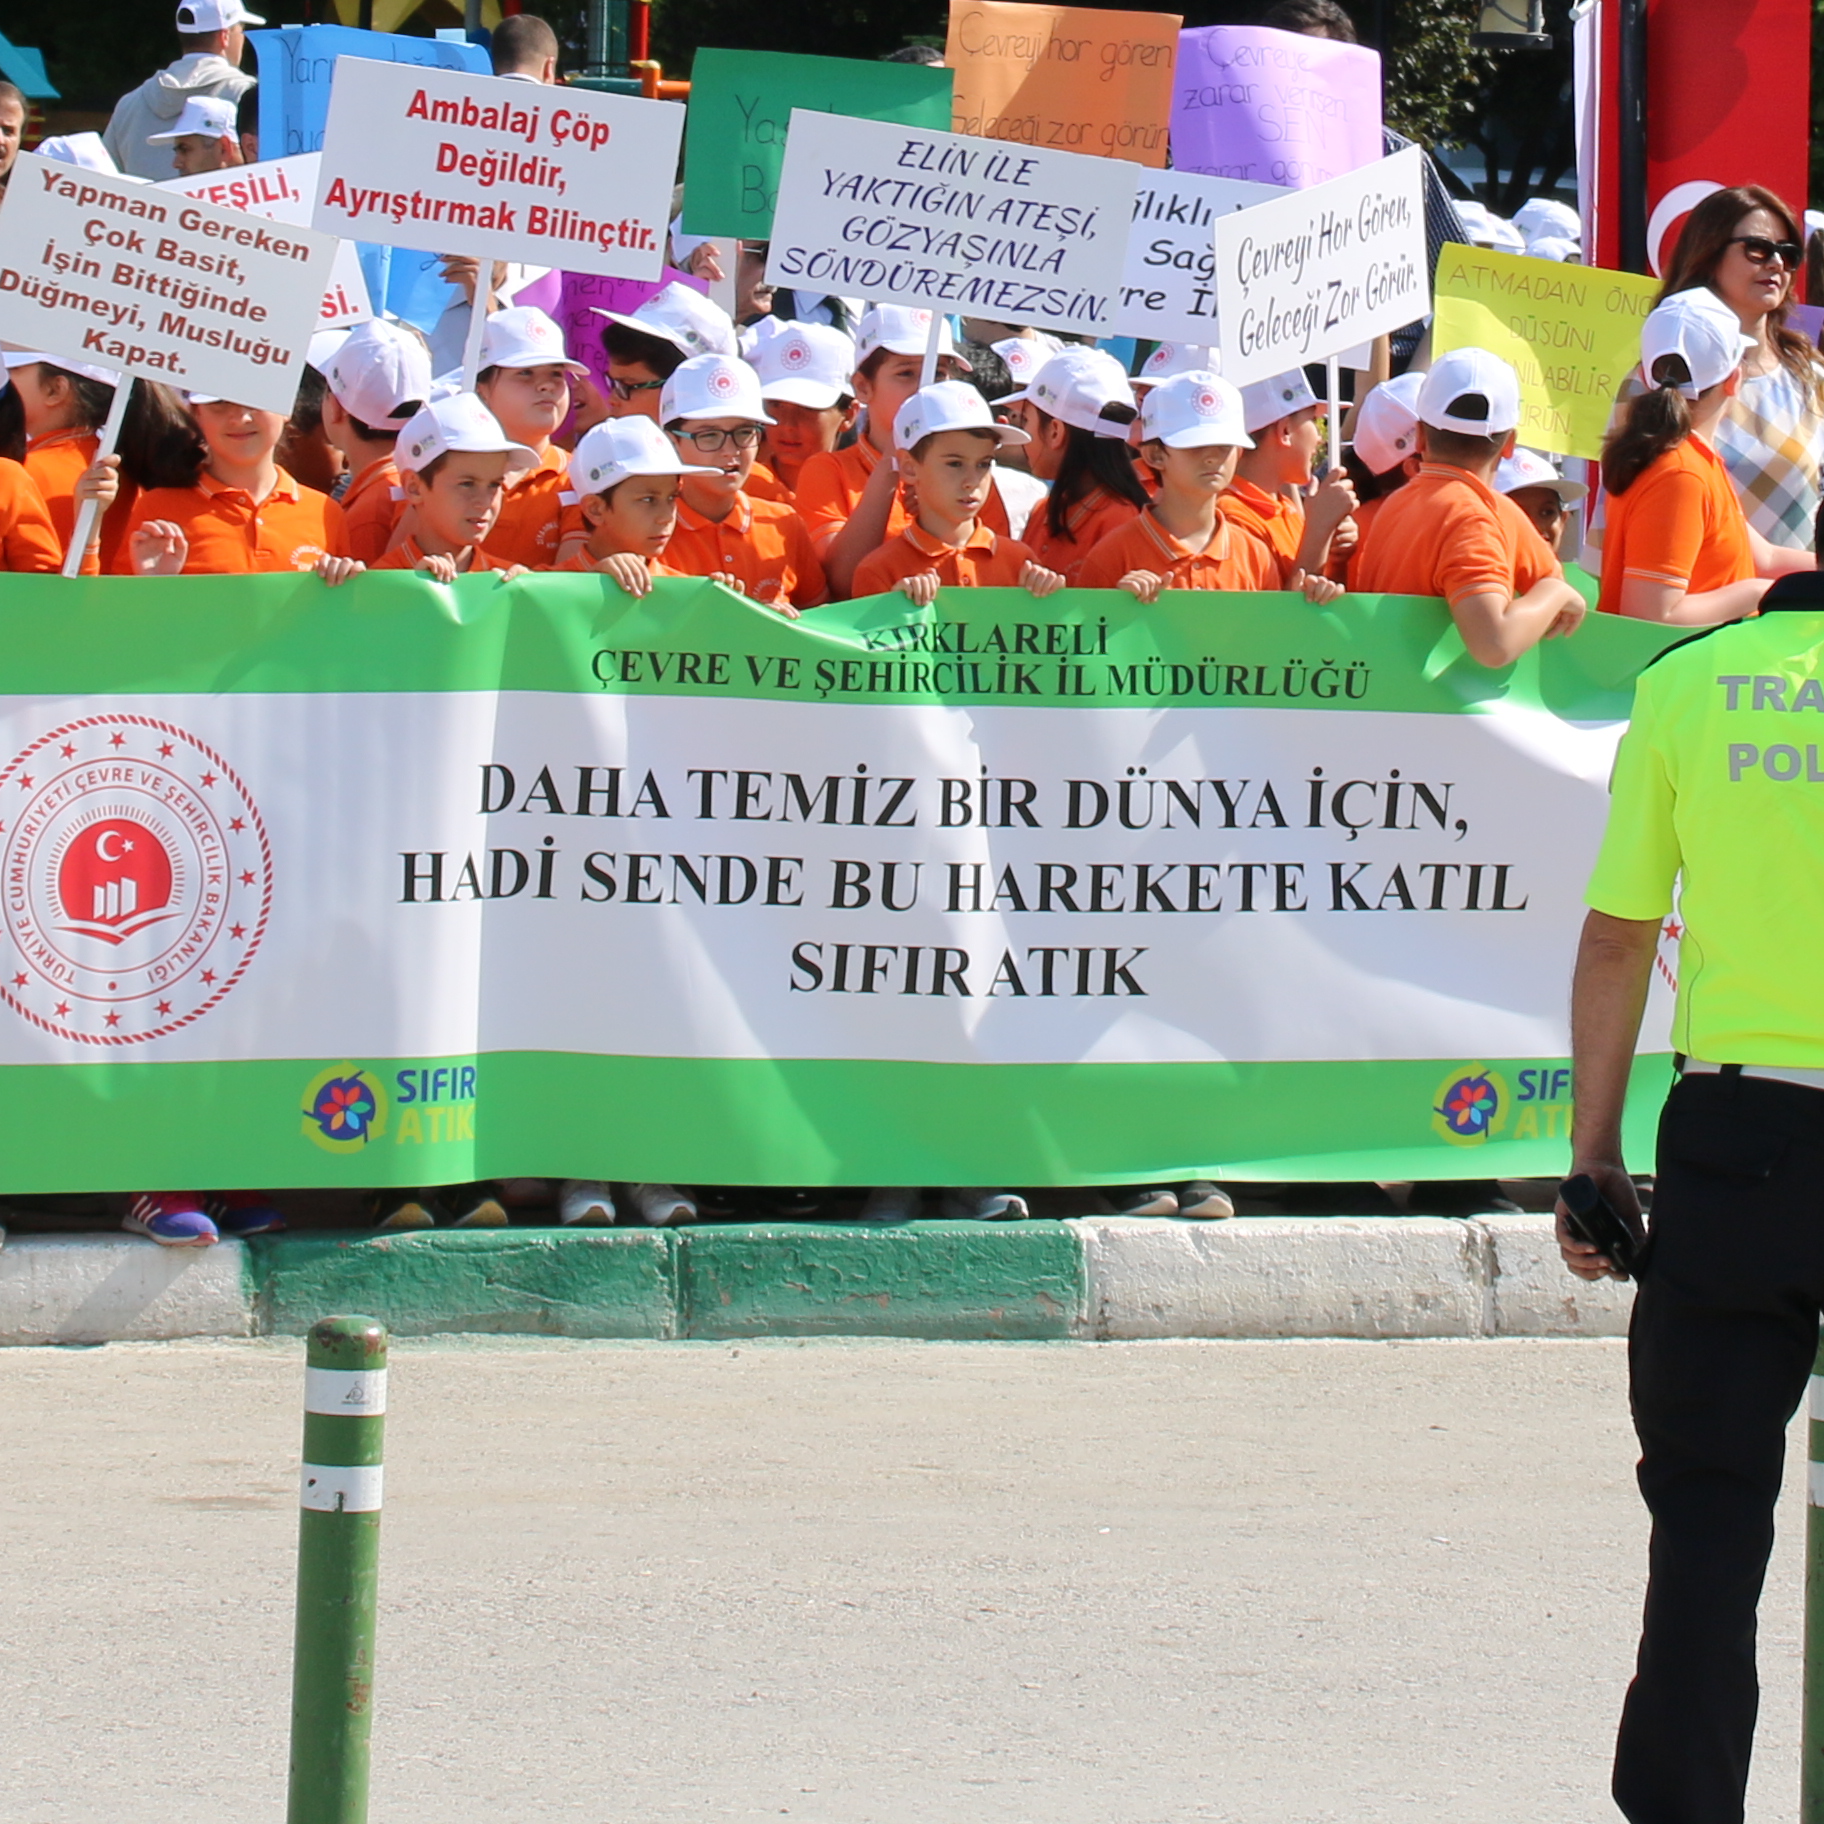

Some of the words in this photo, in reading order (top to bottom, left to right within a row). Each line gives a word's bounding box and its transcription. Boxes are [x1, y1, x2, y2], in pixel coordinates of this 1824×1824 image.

[959, 11, 1042, 72] Çevreyi
[1047, 17, 1092, 62] hor
[1099, 40, 1172, 82] gören
[1206, 27, 1310, 82] Çevreye
[406, 89, 540, 143] Ambalaj
[549, 108, 611, 152] Çöp
[1183, 83, 1259, 110] zarar
[1257, 104, 1326, 149] SEN
[1047, 119, 1092, 145] zor
[435, 142, 567, 197] Değildir,
[897, 140, 979, 177] ELİN
[983, 149, 1041, 187] İLE
[40, 168, 168, 223] Yapman
[178, 208, 310, 263] Gereken
[324, 177, 517, 233] Ayrıştırmak
[526, 204, 658, 253] Bilinçtir.
[822, 168, 986, 221] YAKTIĞIN
[987, 197, 1101, 243] ATEŞİ,
[83, 219, 147, 254] Çok
[156, 237, 246, 286] Basit,
[841, 214, 1067, 276] GÖZYAŞINLA
[1143, 239, 1214, 281] Sağ
[1237, 219, 1315, 300] Çevreyi
[1318, 210, 1353, 259] Hor
[1358, 193, 1411, 243] Gören,
[40, 239, 102, 279] İşin
[111, 262, 268, 323] Bittiğinde
[779, 246, 1108, 324] SÖNDÜREMEZSİN.
[1239, 288, 1321, 357] Geleceği
[1323, 279, 1360, 333] Zor
[1366, 253, 1418, 312] Görür.
[1447, 263, 1588, 308] ATMADAN
[81, 328, 187, 376] Kapat.
[158, 311, 291, 367] Musluğu
[860, 616, 1110, 656] KIRKLARELİ
[591, 648, 731, 690] ÇEVRE
[743, 654, 802, 690] VE
[815, 652, 1043, 700] ŞEHİRCİLİK
[1055, 656, 1097, 696] İL
[1105, 656, 1372, 700] MÜDÜRLÜĞÜ
[75, 767, 134, 793] ÇEVRE
[141, 770, 163, 792] VE
[478, 763, 673, 819] DAHA
[686, 763, 918, 828] TEMİZ
[937, 764, 1042, 829] BİR
[1060, 765, 1289, 831] DÜNYA
[1304, 765, 1469, 842] İÇİN,
[9, 779, 72, 911] CUMHURİYETİ
[163, 785, 223, 886] ŞEHİRCİLİK
[397, 835, 562, 904] HADİ
[580, 851, 805, 906] SENDE
[826, 858, 925, 912] BU
[943, 861, 1308, 914] HAREKETE
[1325, 861, 1530, 912] KATIL
[16, 917, 76, 985] TÜRKİYE
[146, 892, 221, 984] BAKANLIĞI
[789, 940, 972, 998] SIFIR
[986, 945, 1151, 998] ATIK
[396, 1065, 476, 1104] SIFIR
[395, 1104, 476, 1145] ATIK
